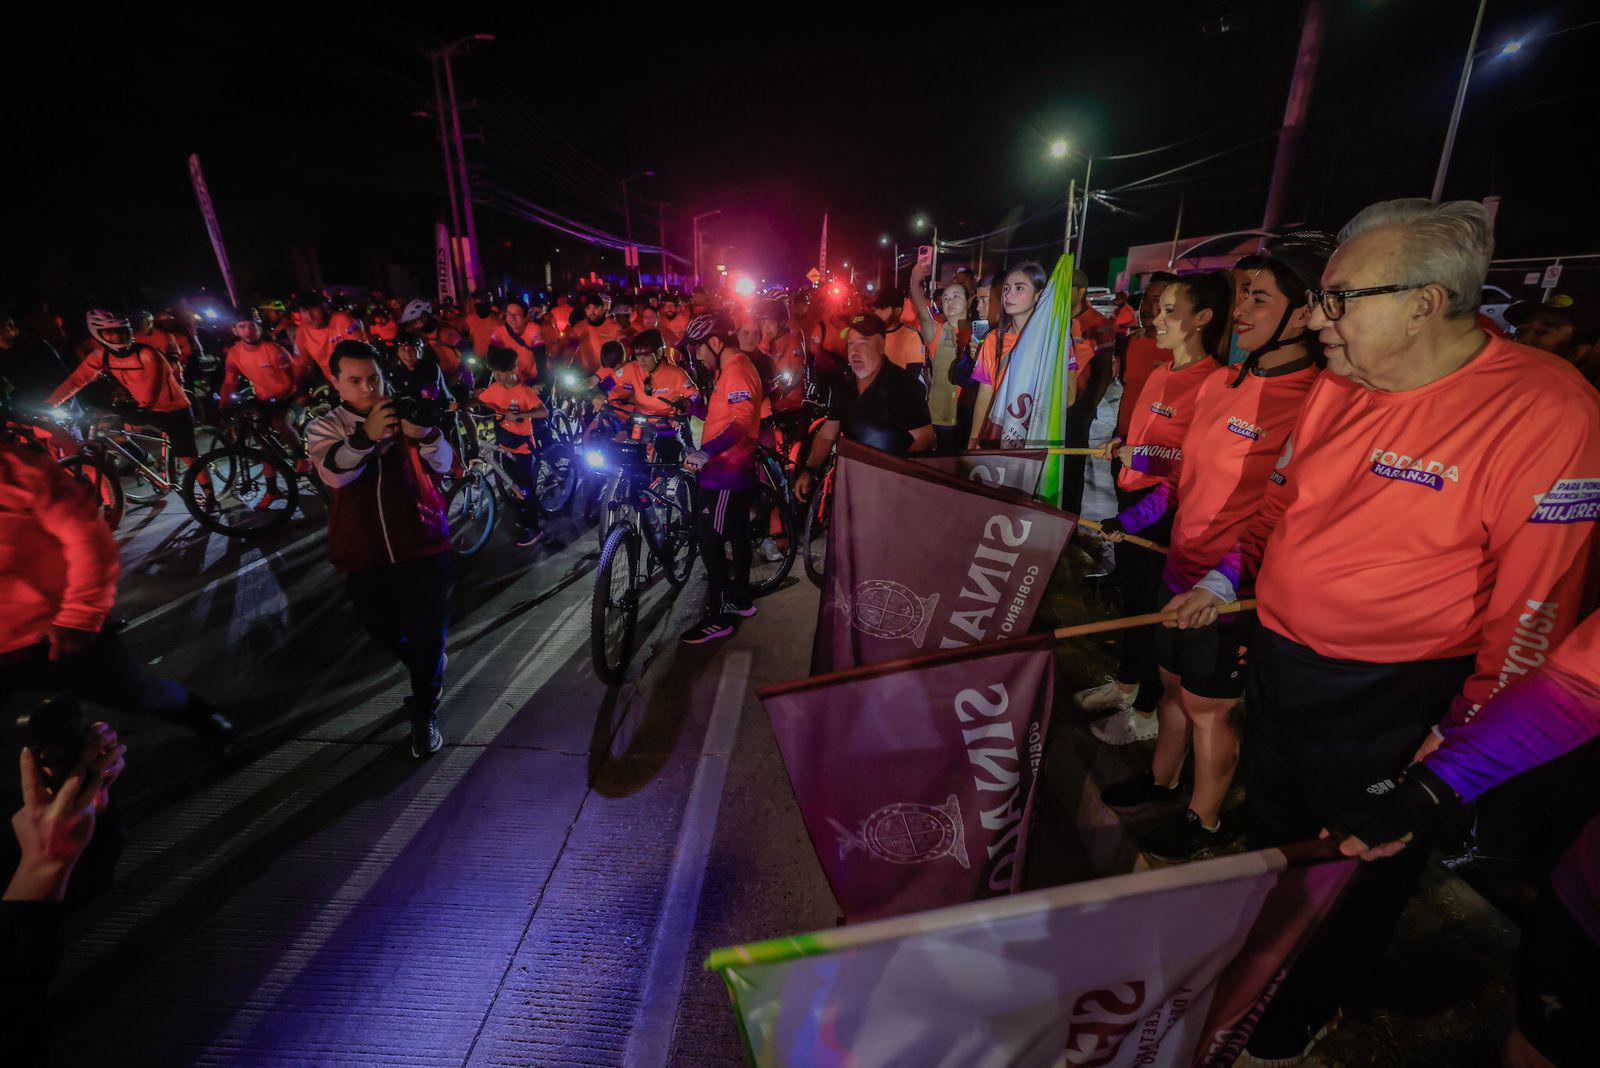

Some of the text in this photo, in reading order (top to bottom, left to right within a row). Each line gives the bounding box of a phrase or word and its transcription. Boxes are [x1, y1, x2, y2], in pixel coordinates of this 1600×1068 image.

[1369, 447, 1460, 482] RODADA
[1374, 463, 1437, 487] NARANJA
[1530, 502, 1600, 521] MUJERES
